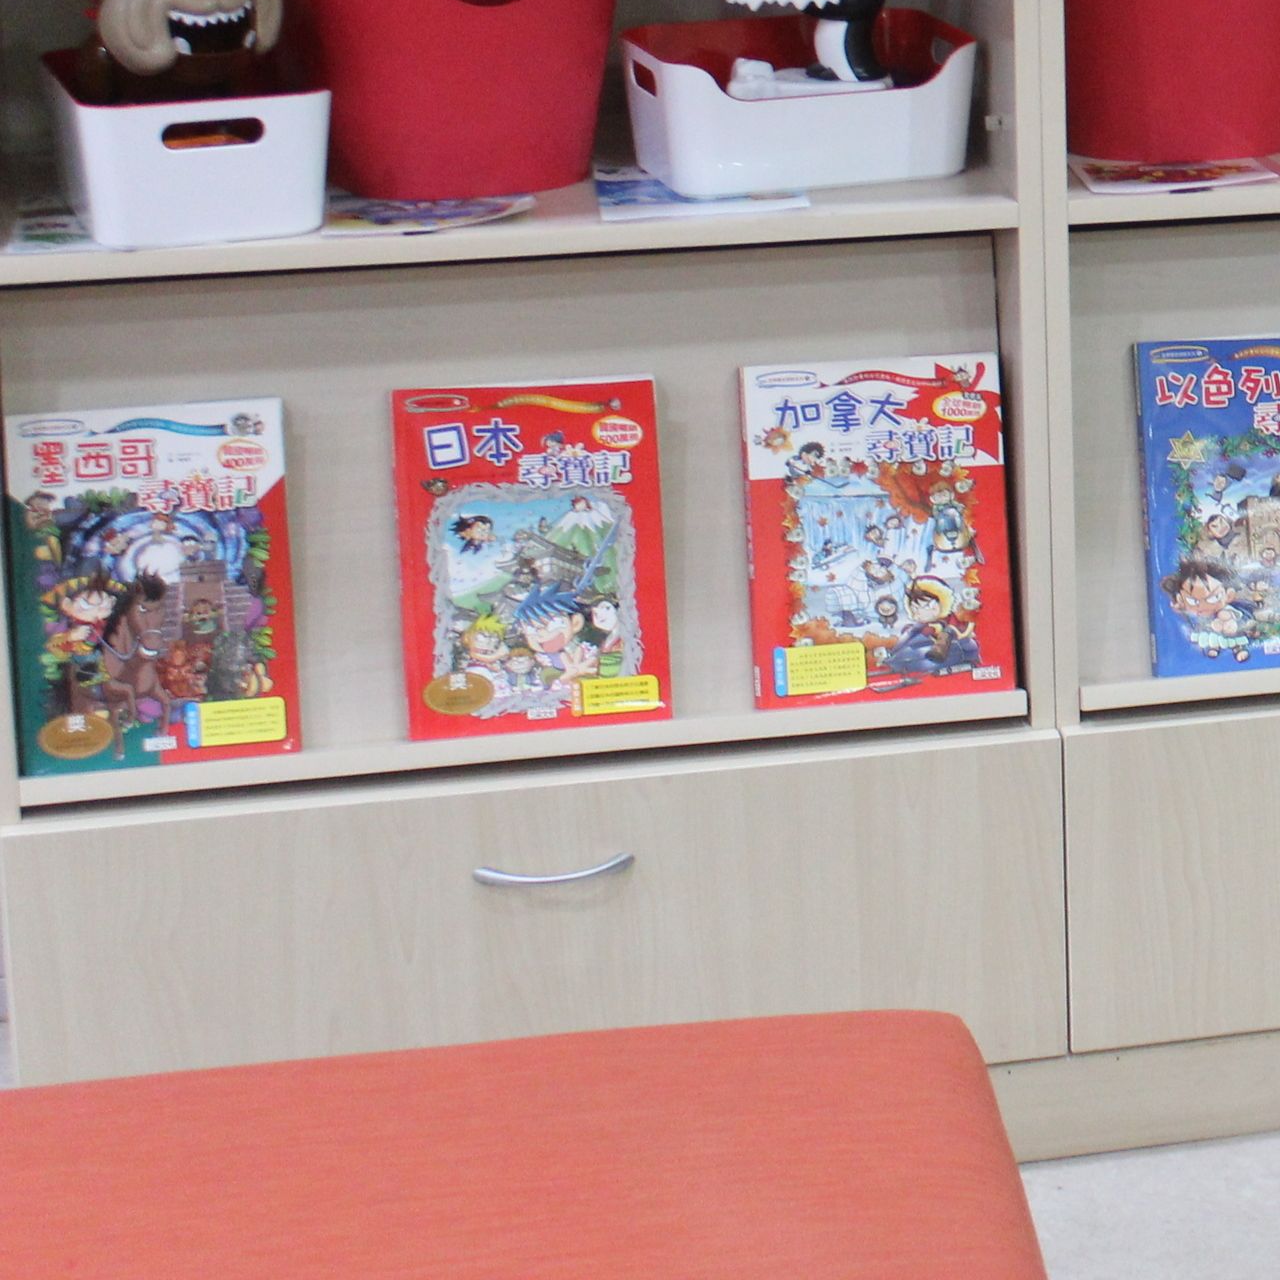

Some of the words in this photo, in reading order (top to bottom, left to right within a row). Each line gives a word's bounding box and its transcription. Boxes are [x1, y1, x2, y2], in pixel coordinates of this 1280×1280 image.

[775, 390, 908, 433] 加拿大
[33, 437, 157, 486] 墨西哥
[424, 418, 524, 470] 日本
[866, 423, 976, 462] 尋寶記
[518, 449, 633, 489] 尋寶記
[137, 473, 257, 514] 尋寶記
